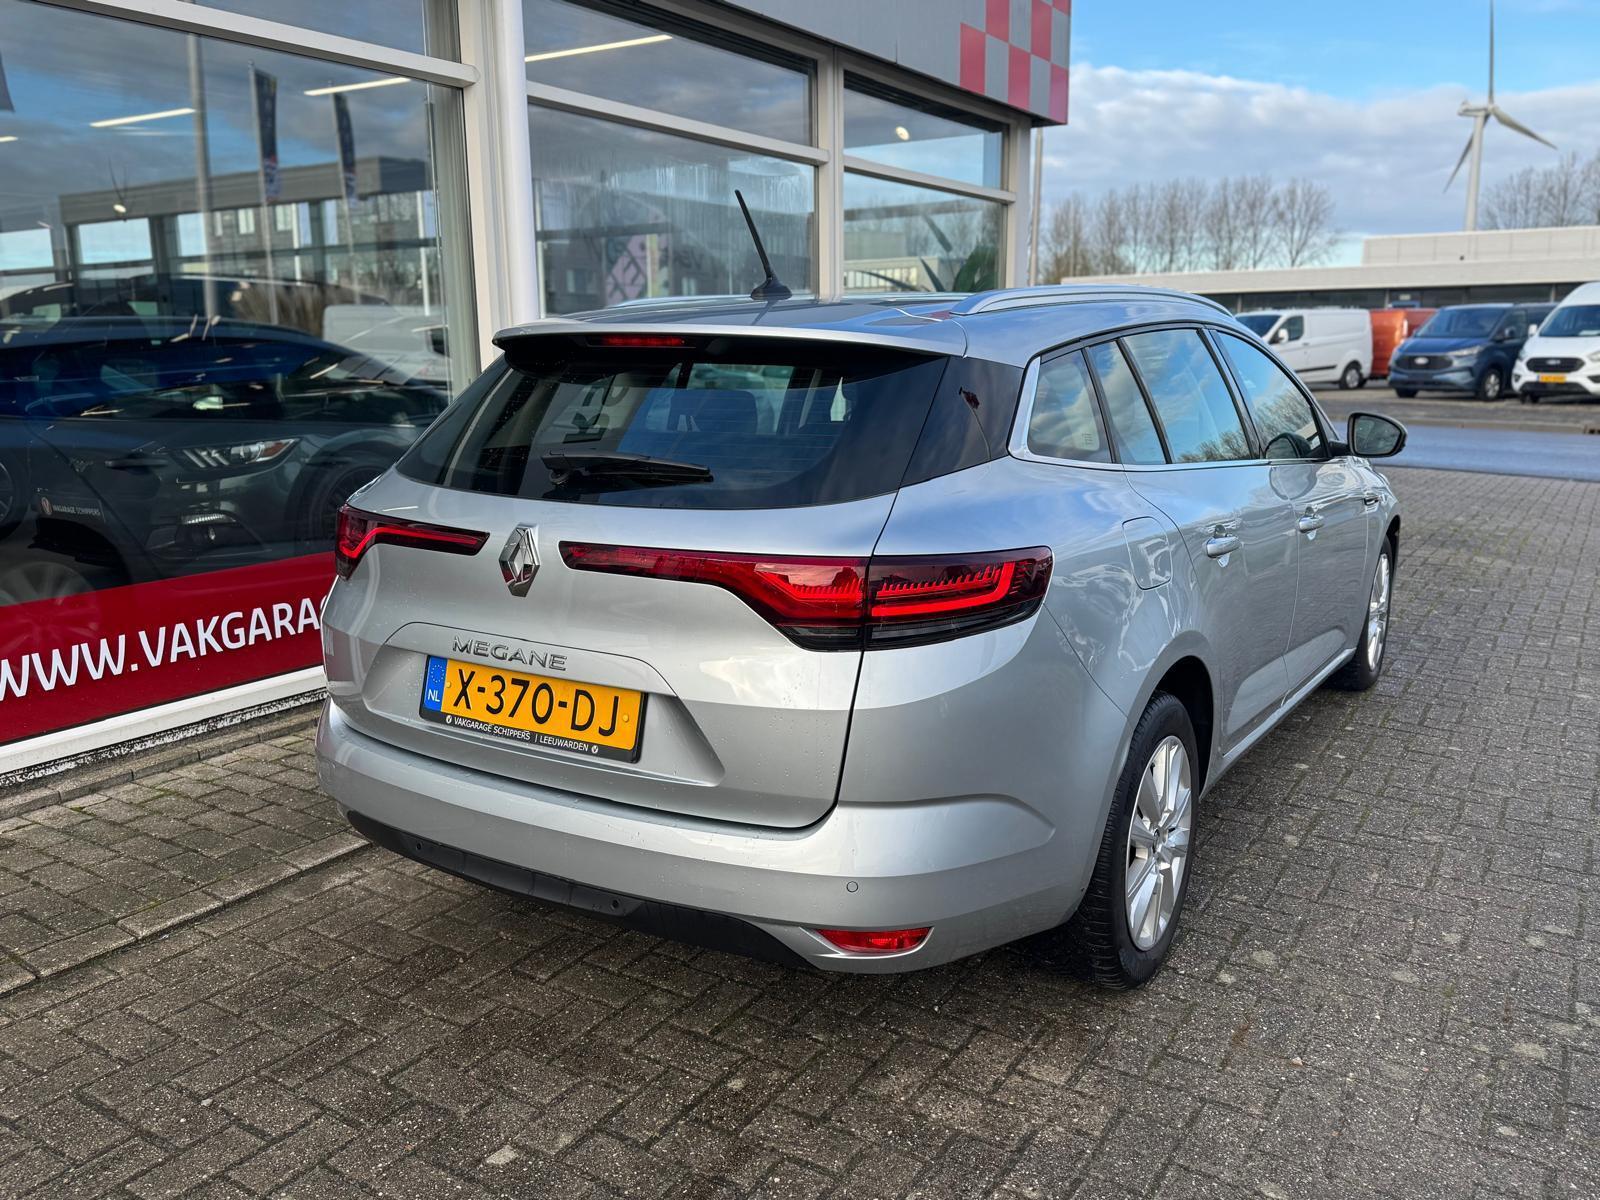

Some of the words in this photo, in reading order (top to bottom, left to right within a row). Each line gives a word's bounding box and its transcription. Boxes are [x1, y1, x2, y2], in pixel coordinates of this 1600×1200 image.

[0, 594, 328, 700] WWW.VAKGARA
[452, 635, 568, 671] MEGANE
[427, 688, 441, 703] NL
[453, 668, 619, 736] X-370-DJ
[454, 716, 492, 733] VAKGARAGE
[493, 726, 531, 741] SCHIPPERS
[539, 735, 589, 752] LEEUWARDEN
